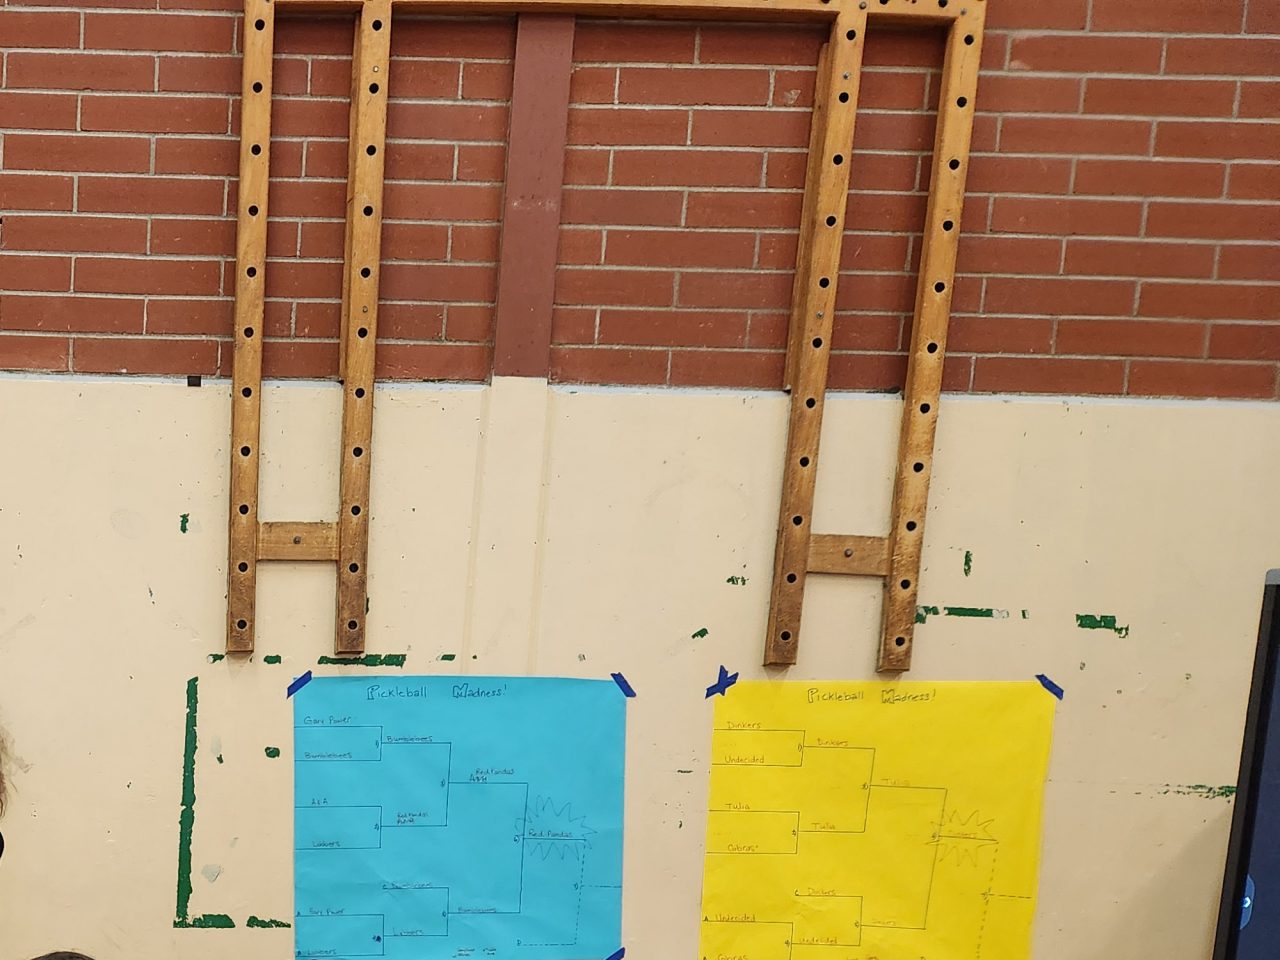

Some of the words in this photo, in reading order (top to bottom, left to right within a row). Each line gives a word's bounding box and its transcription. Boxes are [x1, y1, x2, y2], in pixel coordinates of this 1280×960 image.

[367, 685, 427, 700] Pickleball
[453, 683, 507, 698] Madness!
[808, 688, 864, 703] Pickleball
[881, 689, 936, 704] Madness!
